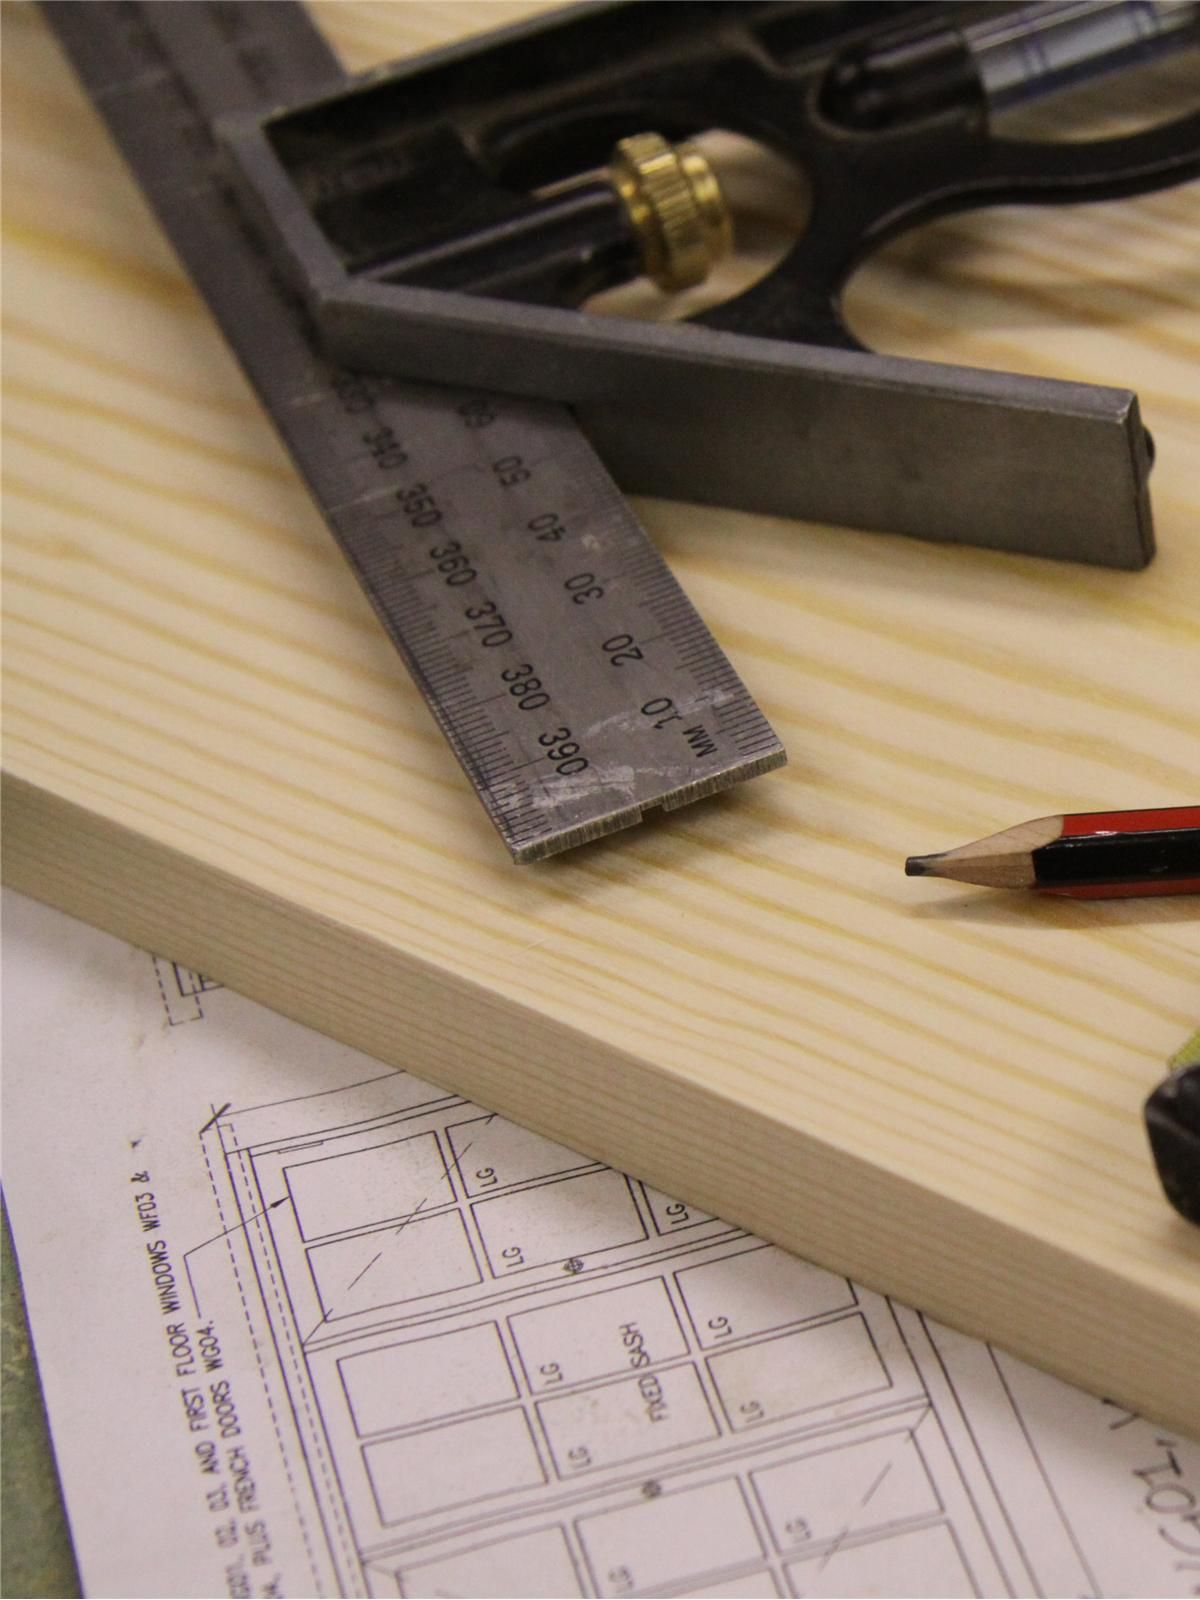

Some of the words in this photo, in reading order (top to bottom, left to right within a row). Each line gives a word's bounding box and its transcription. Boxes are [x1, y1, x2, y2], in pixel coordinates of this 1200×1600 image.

[492, 455, 532, 487] 50
[396, 483, 442, 528] 350
[527, 513, 566, 541] 40
[430, 540, 477, 586] 360
[563, 573, 604, 605] 30
[465, 601, 513, 648] 370
[602, 634, 644, 667] 20
[501, 663, 550, 711] 380
[640, 697, 682, 729] 10
[538, 727, 588, 776] 390
[682, 724, 718, 758] MM
[131, 1170, 150, 1184] &
[476, 1167, 498, 1188] LG
[135, 1192, 161, 1233] WF03
[666, 1203, 689, 1225] LG
[502, 1246, 525, 1268] LG
[147, 1240, 182, 1316] WINDOWS
[196, 1320, 224, 1373] WG04.
[619, 1321, 650, 1369] SASH
[708, 1316, 733, 1339] LG
[165, 1322, 197, 1377] FLOOR
[540, 1362, 563, 1385] LG
[181, 1387, 209, 1433] FIRST
[210, 1380, 242, 1439] DOORS
[638, 1374, 669, 1423] FIXED
[740, 1401, 765, 1423] LG
[195, 1440, 220, 1475] AND
[226, 1446, 260, 1514] FRENCH
